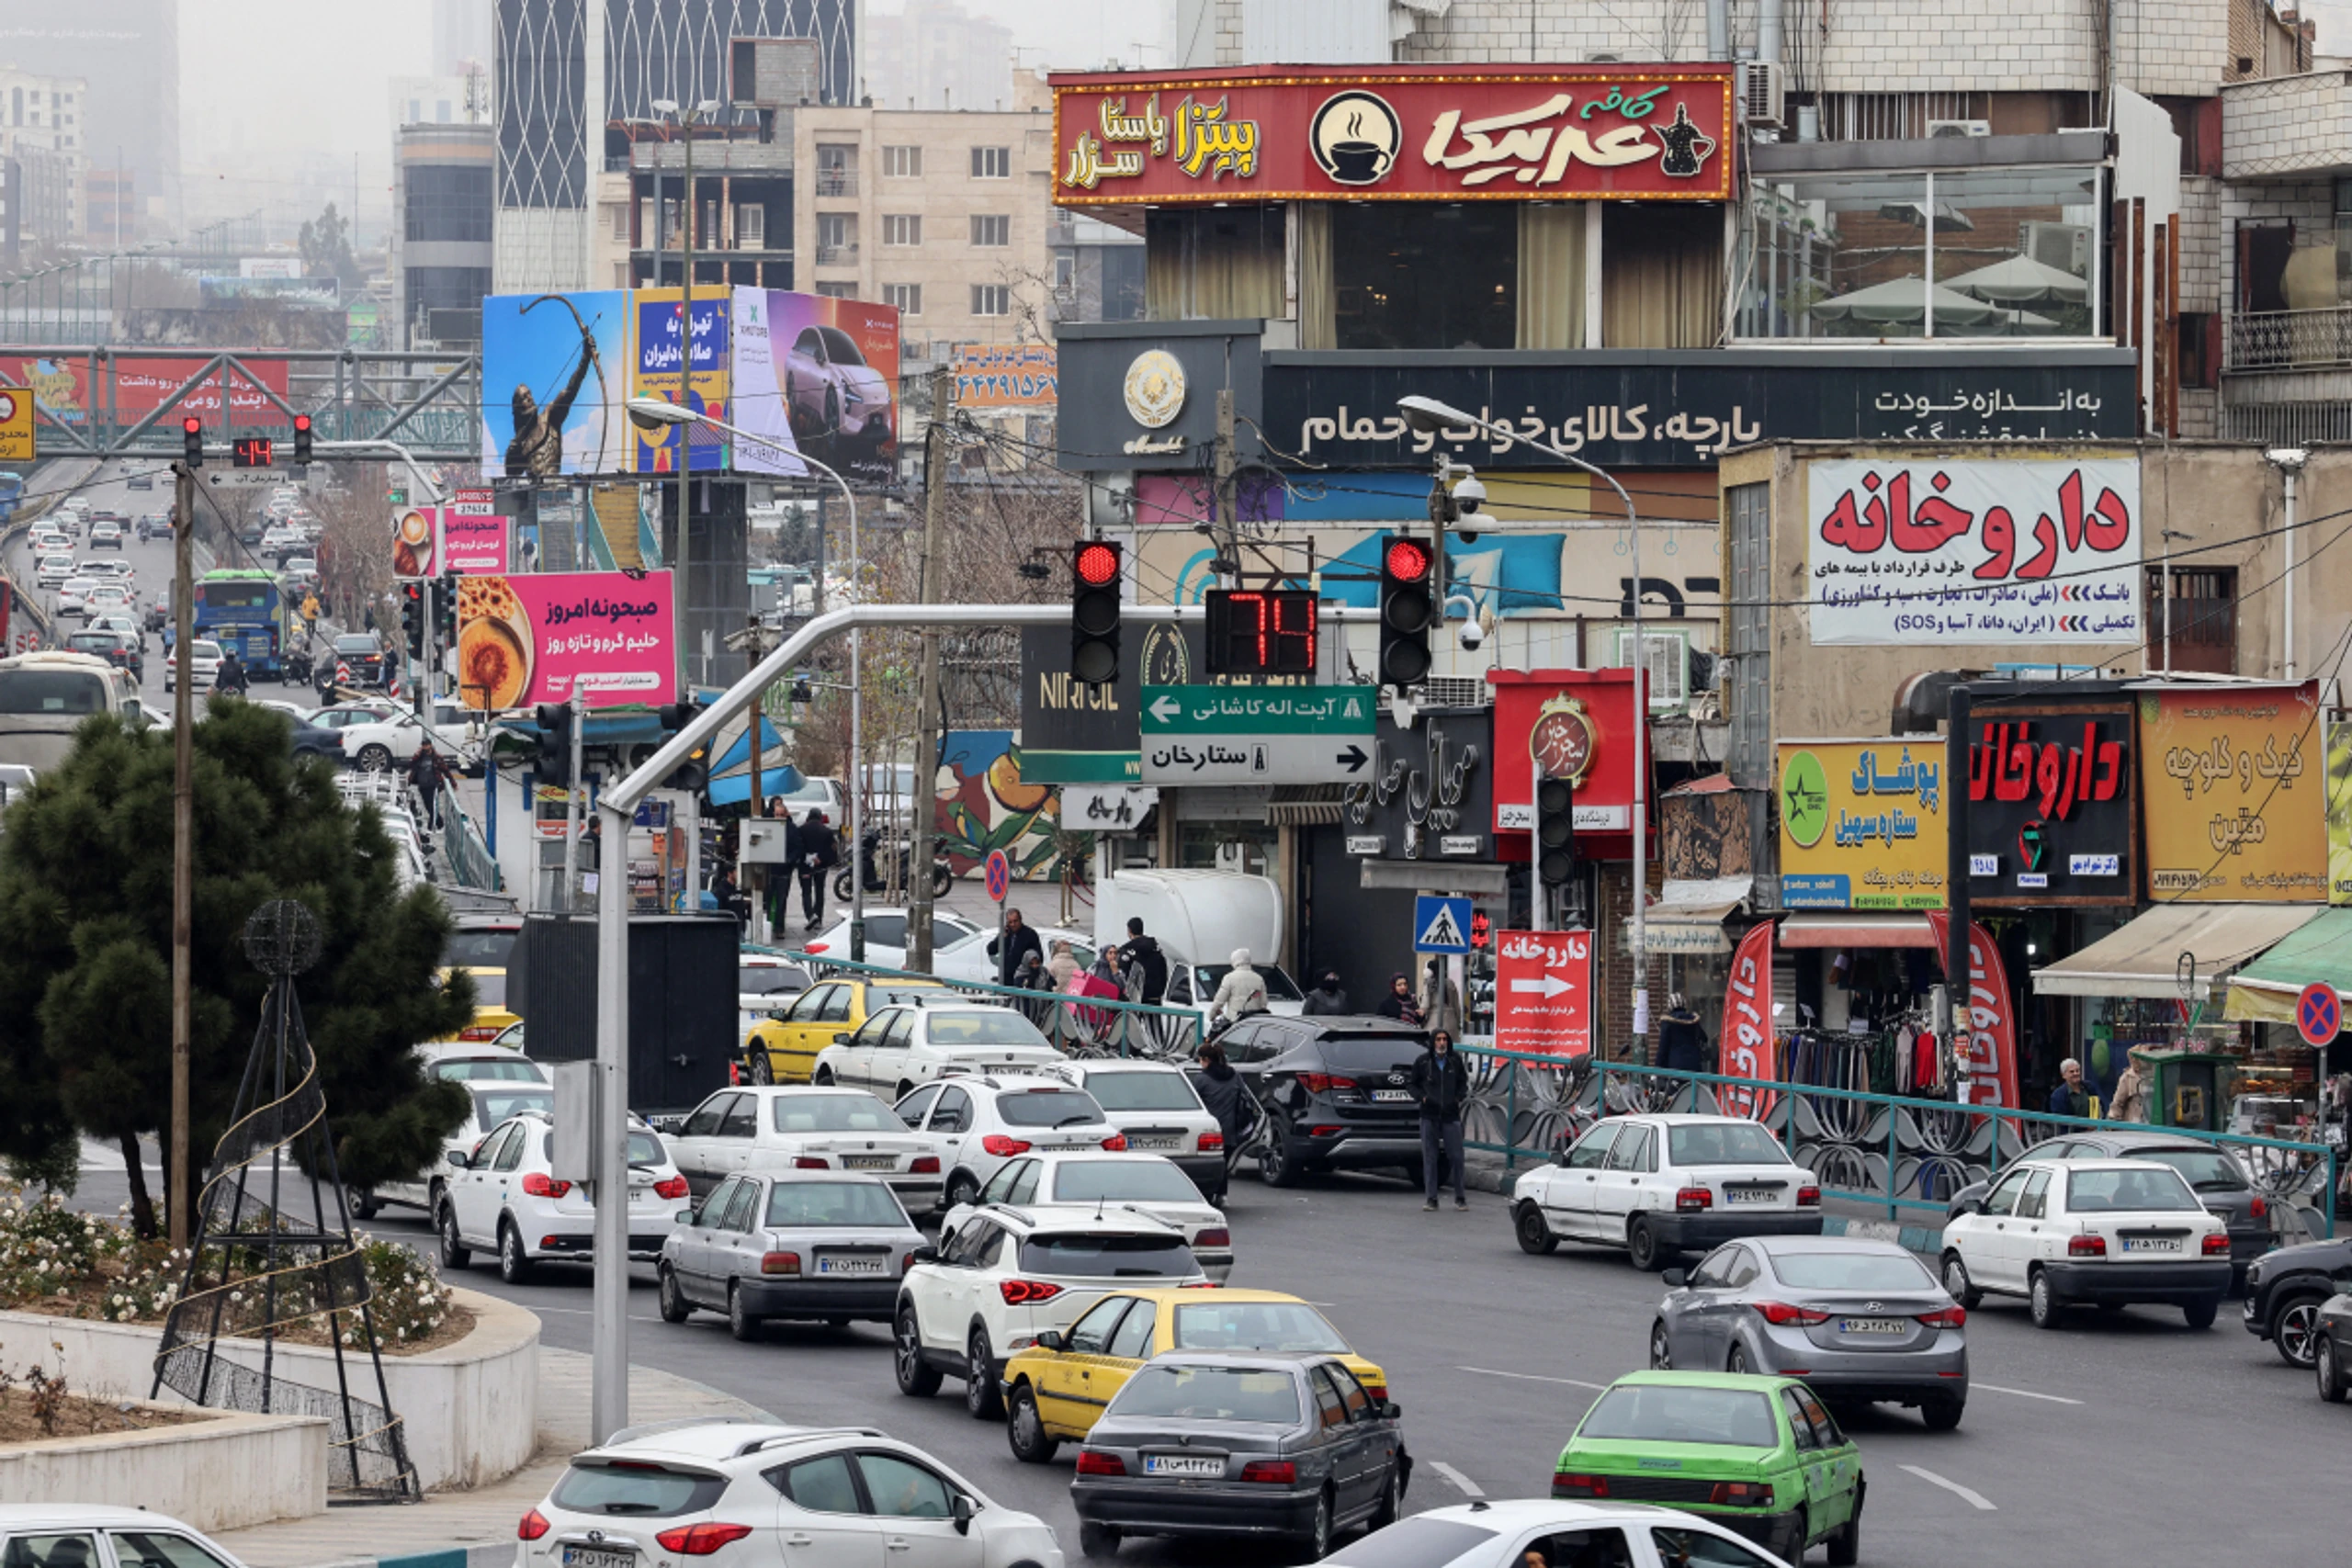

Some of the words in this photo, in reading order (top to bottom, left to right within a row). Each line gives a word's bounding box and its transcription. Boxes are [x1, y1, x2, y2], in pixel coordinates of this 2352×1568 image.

[1580, 85, 1669, 118] کافه
[1099, 92, 1170, 156] پاستا
[1175, 94, 1260, 181] پیتزا
[1423, 94, 1660, 187] عربیکا
[1060, 130, 1144, 189] سزار
[666, 316, 678, 337] به
[645, 344, 677, 367] دلیران
[1875, 389, 1969, 418] خودت
[1972, 389, 2072, 418] اندازه
[2075, 392, 2101, 416] به
[1302, 404, 1405, 455] حمام
[1550, 404, 1647, 454] کالای
[250, 475, 279, 485] سازمان
[1821, 469, 2130, 580] داروخانه
[1815, 560, 1839, 578] های
[1845, 564, 1868, 578] بیمه
[1871, 560, 1881, 578] با
[1883, 558, 1929, 578] قرارداد
[1934, 560, 1965, 578] طرف
[2093, 582, 2130, 604] بانک
[545, 598, 589, 625] امروز
[591, 598, 658, 624] صبحونه
[1948, 613, 1973, 630] آسیا
[2092, 614, 2135, 633] تکمیلی
[567, 633, 591, 654] تازه
[602, 631, 625, 653] گرم
[627, 632, 660, 652] حلیم
[1228, 592, 1315, 669] 74
[546, 636, 566, 655] روز
[593, 637, 601, 654] و
[1193, 699, 1264, 720] کاشانی
[1266, 699, 1293, 715] اله
[1295, 697, 1336, 720] آیت
[1152, 744, 1247, 772] ستارخان
[1970, 721, 2121, 821] داروخان
[2165, 735, 2235, 800] کلوچه
[2256, 732, 2304, 789] کیک
[1851, 746, 1939, 814] پوشاک
[2237, 750, 2253, 794] و
[1834, 807, 1878, 847] سهیل
[1879, 807, 1917, 849] ستاره
[2210, 807, 2267, 855] متین
[1501, 936, 1587, 967] داروخانه
